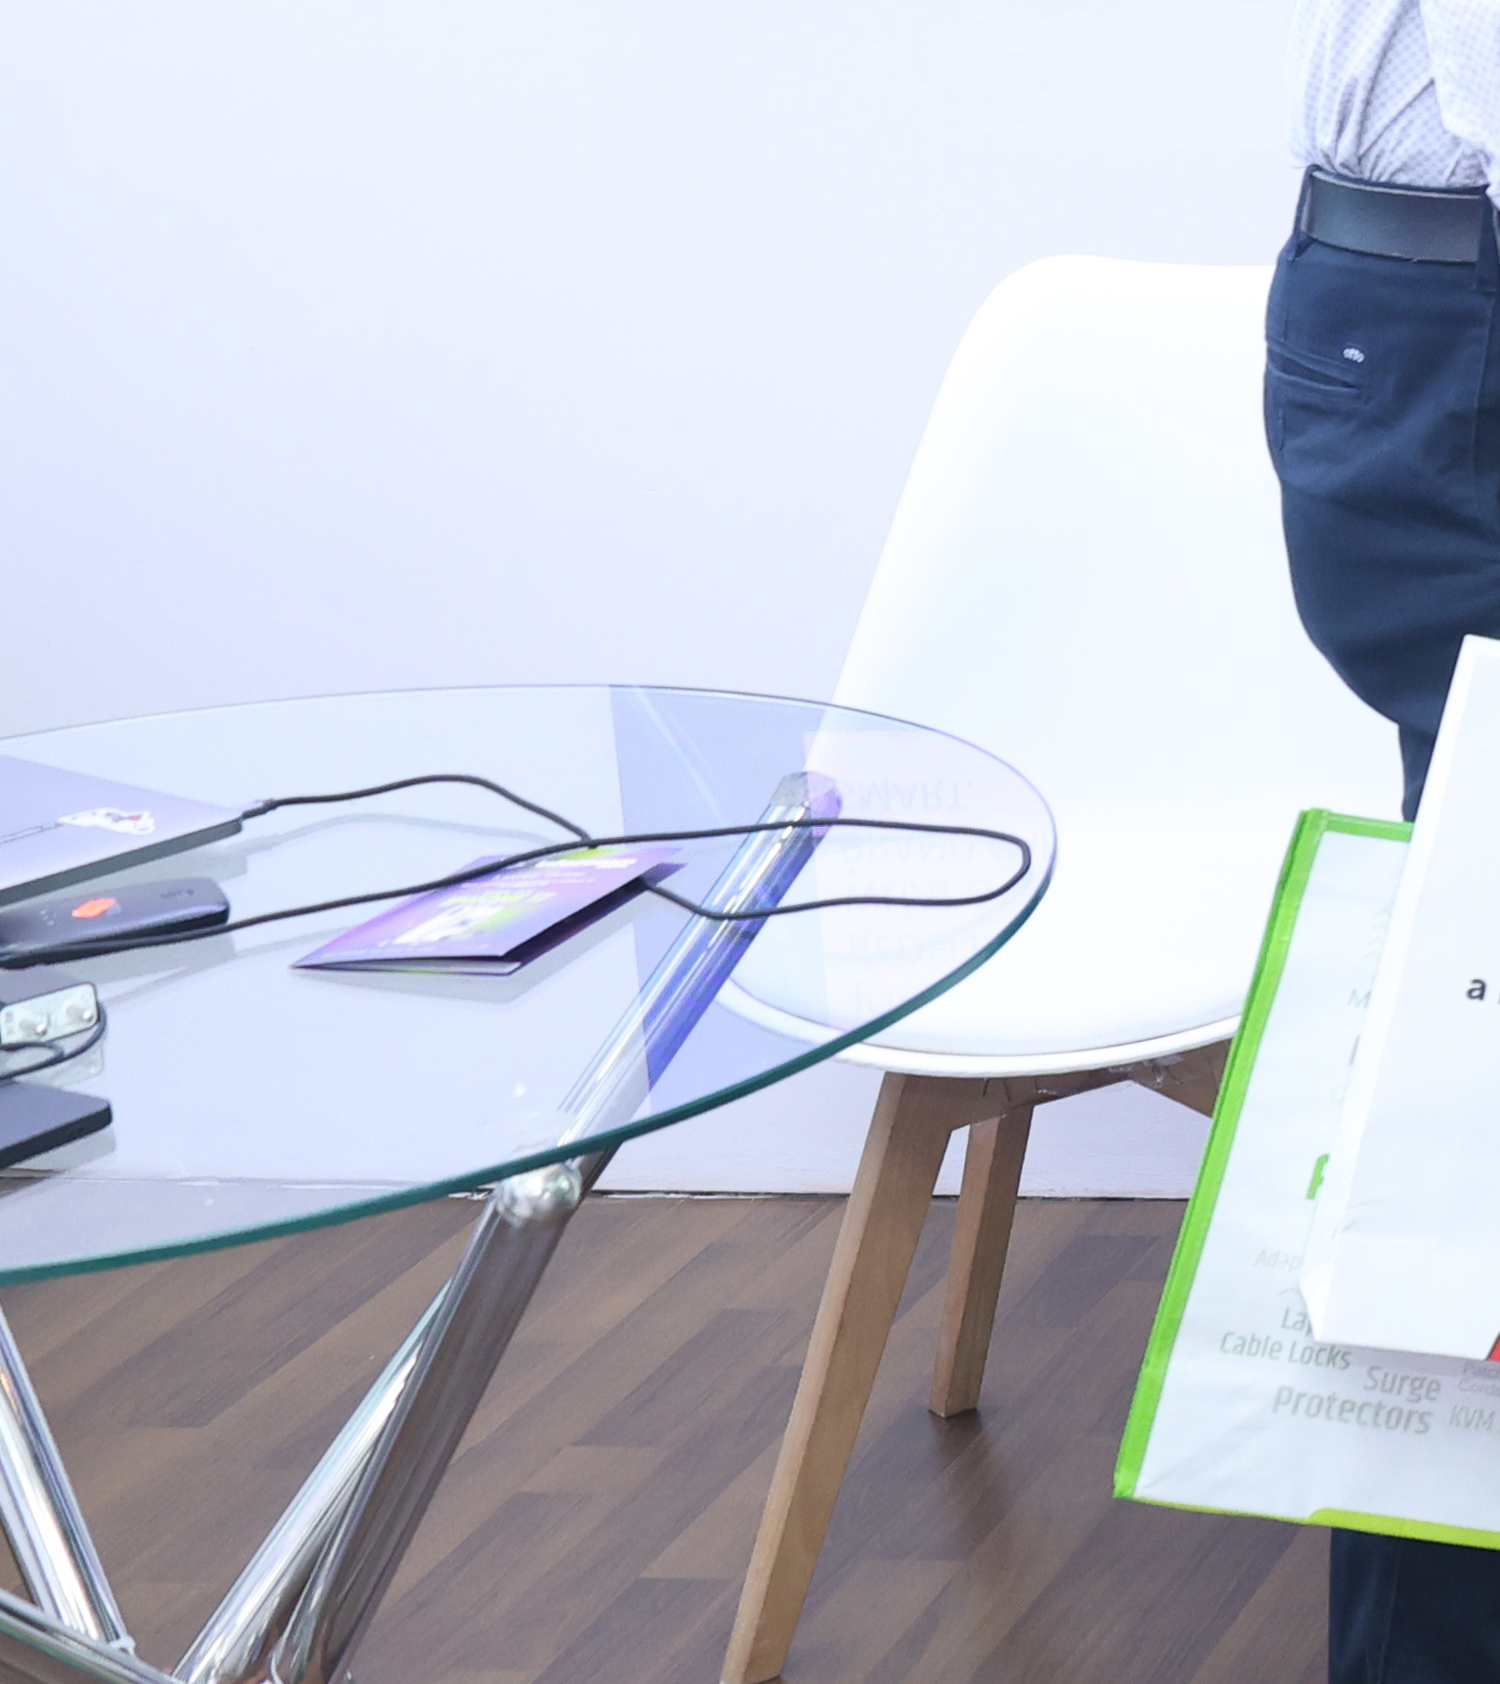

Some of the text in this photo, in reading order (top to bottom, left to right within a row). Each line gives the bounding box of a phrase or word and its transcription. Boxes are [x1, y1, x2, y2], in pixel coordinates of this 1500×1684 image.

[1465, 978, 1488, 1001] a
[1254, 1247, 1302, 1273] Adap
[1220, 1330, 1353, 1370] Cable Locks
[1363, 1365, 1441, 1403] Surge
[1272, 1385, 1434, 1435] Protectors
[1448, 1404, 1496, 1431] KVM
